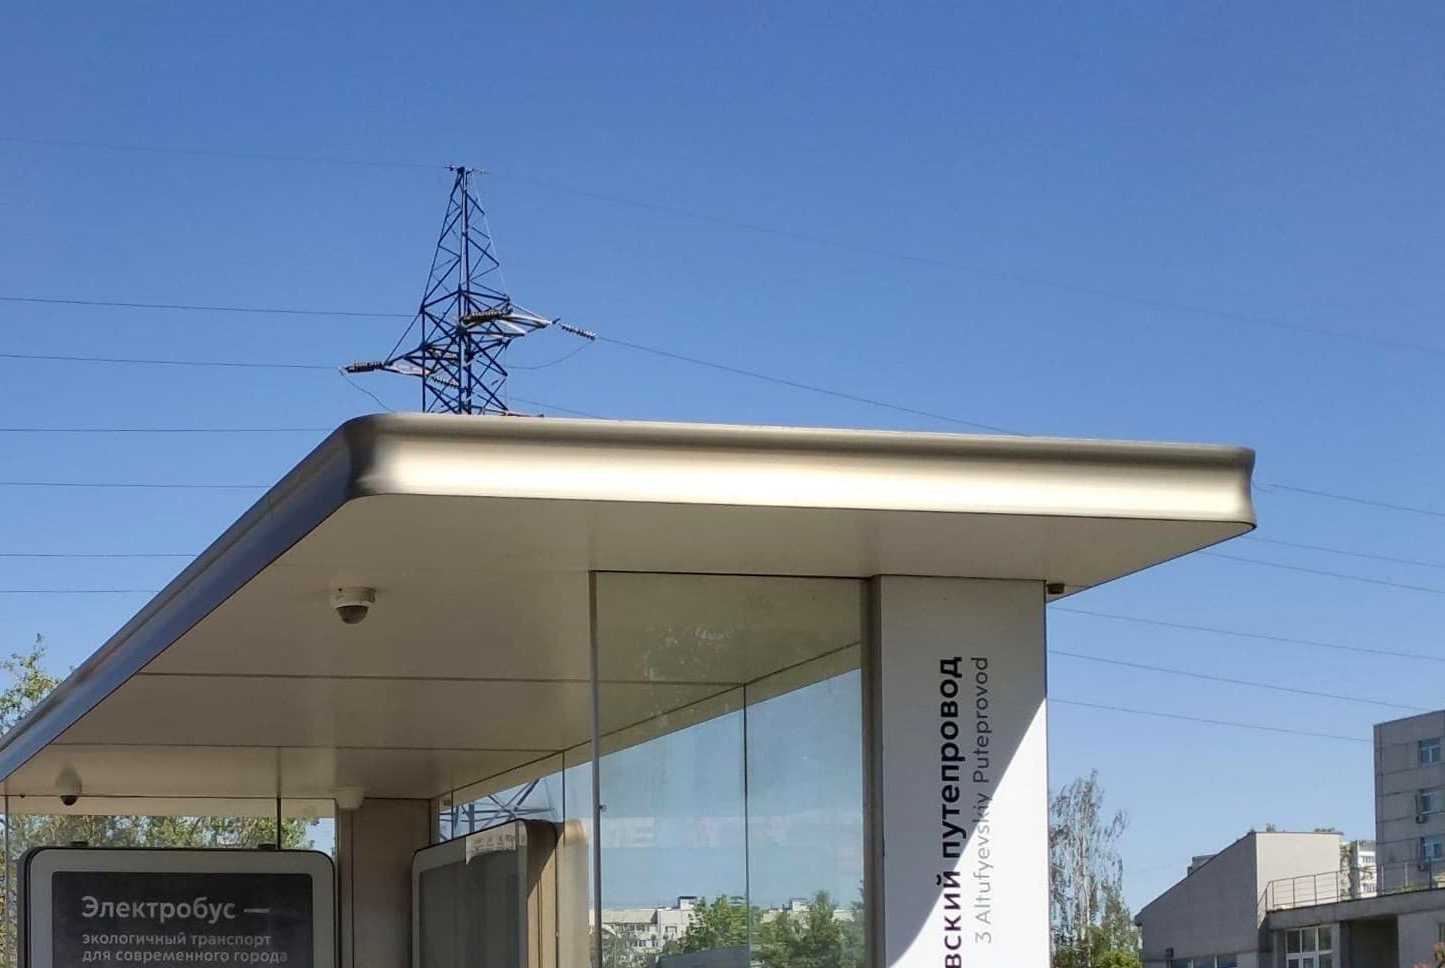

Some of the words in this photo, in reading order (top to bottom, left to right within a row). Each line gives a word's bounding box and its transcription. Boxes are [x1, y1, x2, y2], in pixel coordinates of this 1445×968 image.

[970, 657, 992, 783] Puteprovod
[939, 656, 967, 858] путепровод
[971, 793, 994, 925] Altufyevskiy
[82, 895, 236, 924] Электробус
[82, 932, 187, 946] экологичный
[189, 933, 272, 948] транспорт
[974, 931, 992, 945] 3
[82, 950, 111, 963] для
[115, 950, 230, 964] современного
[234, 951, 288, 964] города
